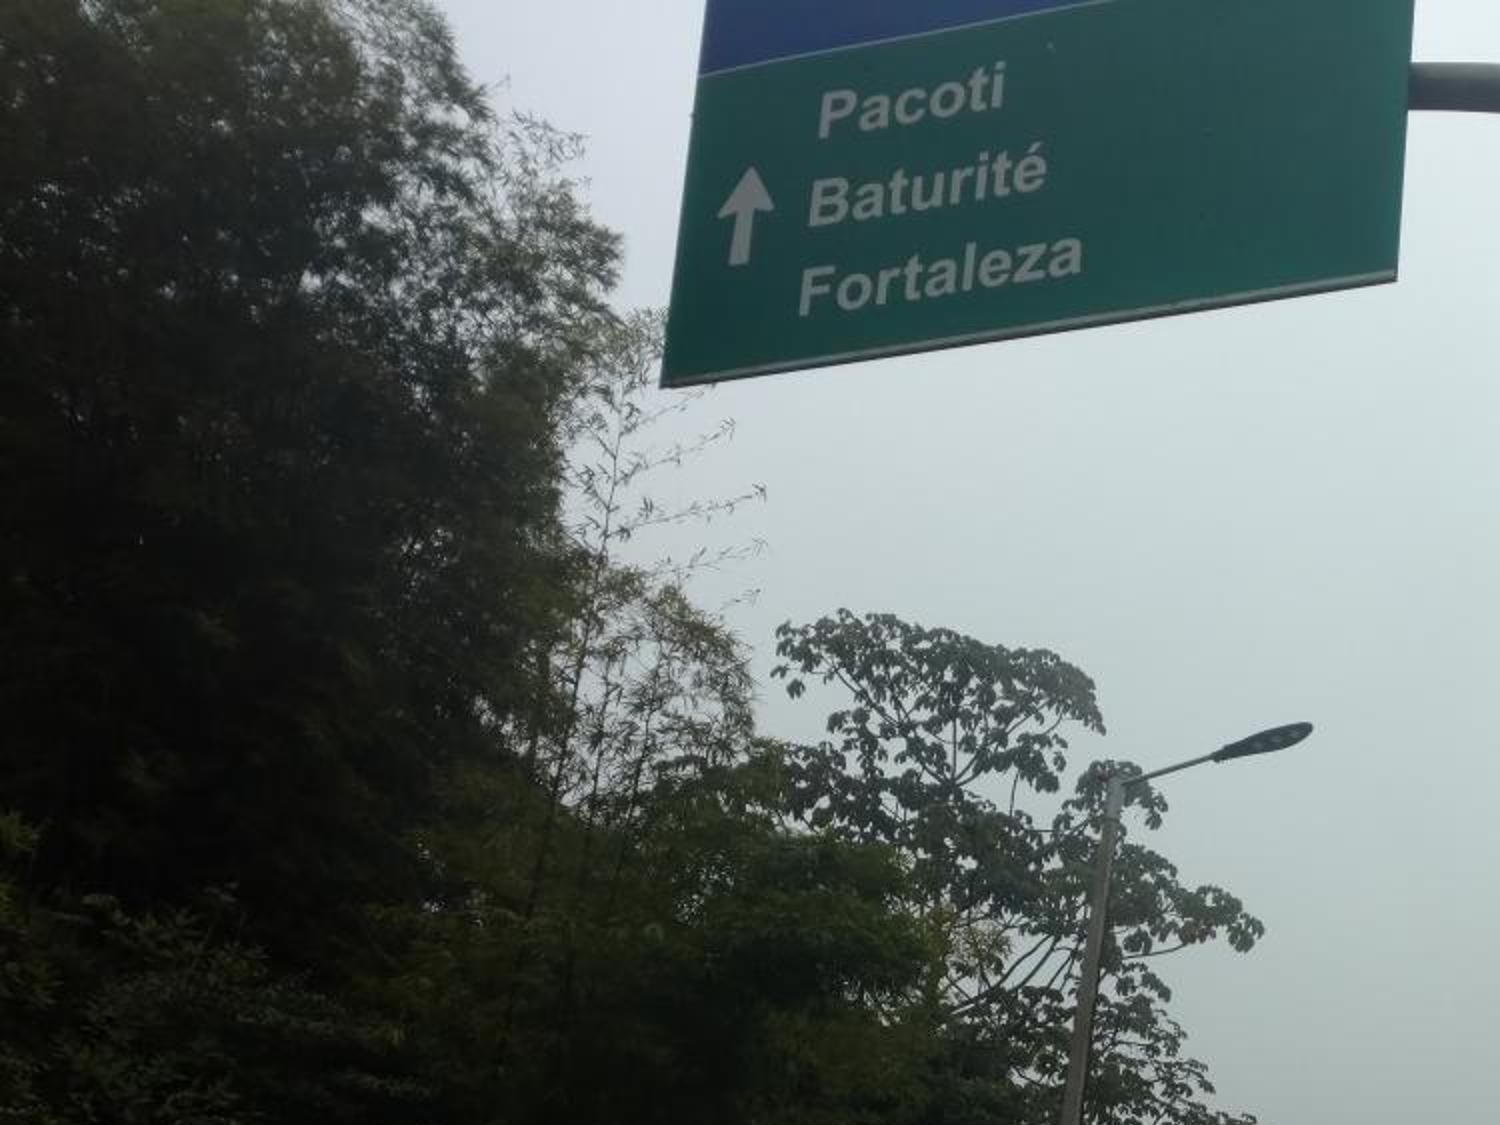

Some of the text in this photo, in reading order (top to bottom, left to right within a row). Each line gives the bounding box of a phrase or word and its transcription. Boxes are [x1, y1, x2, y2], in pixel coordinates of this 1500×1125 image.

[819, 61, 1005, 138] Pacoti
[808, 142, 1047, 228] Baturité
[800, 237, 1082, 317] Fortaleza
